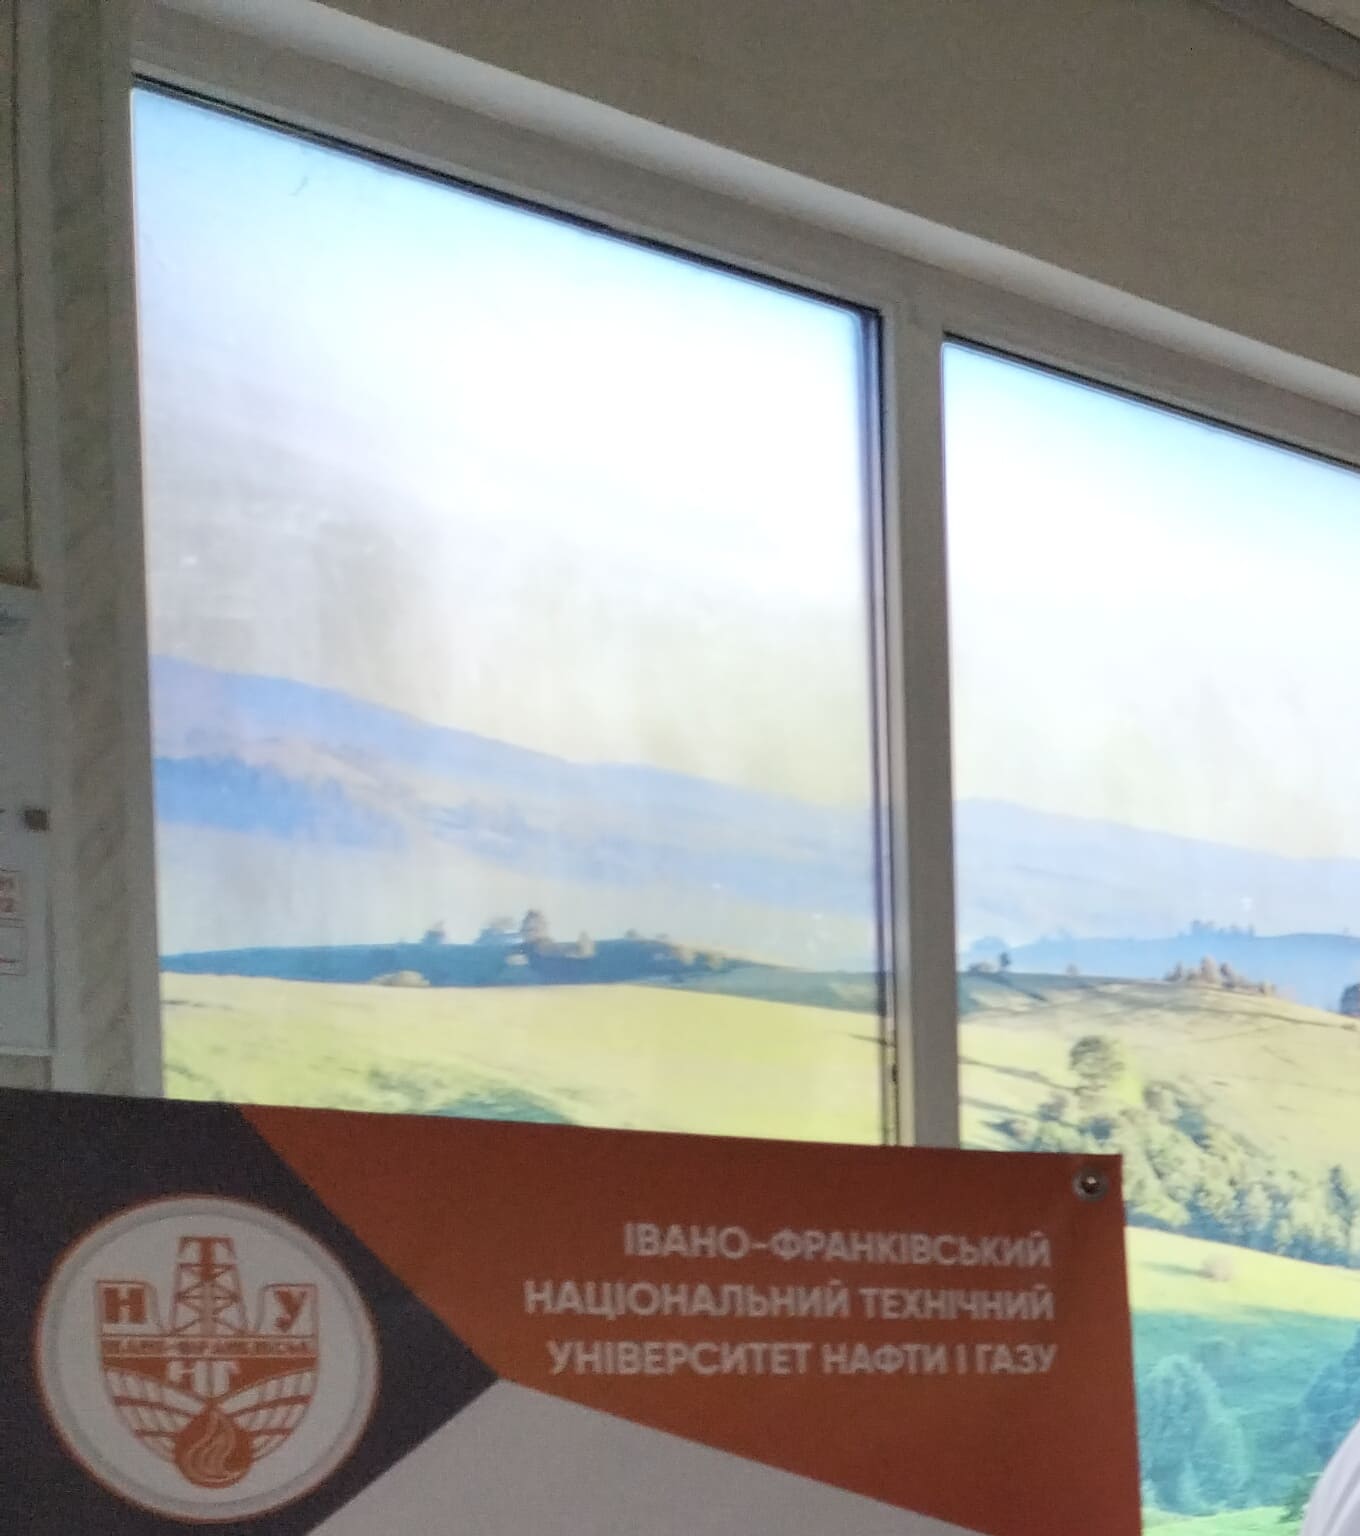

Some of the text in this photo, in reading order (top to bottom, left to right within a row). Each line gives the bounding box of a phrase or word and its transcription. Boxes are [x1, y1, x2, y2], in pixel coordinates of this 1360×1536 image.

[623, 1223, 1052, 1268] ІВАНО-ФРАНКІВСЬКИЙ
[523, 1279, 1055, 1321] НАЦІОНАЛЬНИЙ ТЕХНІЧНИЙ
[546, 1340, 1057, 1376] УНІВЕРСИТЕТ НАФТИ І ГАЗУ
